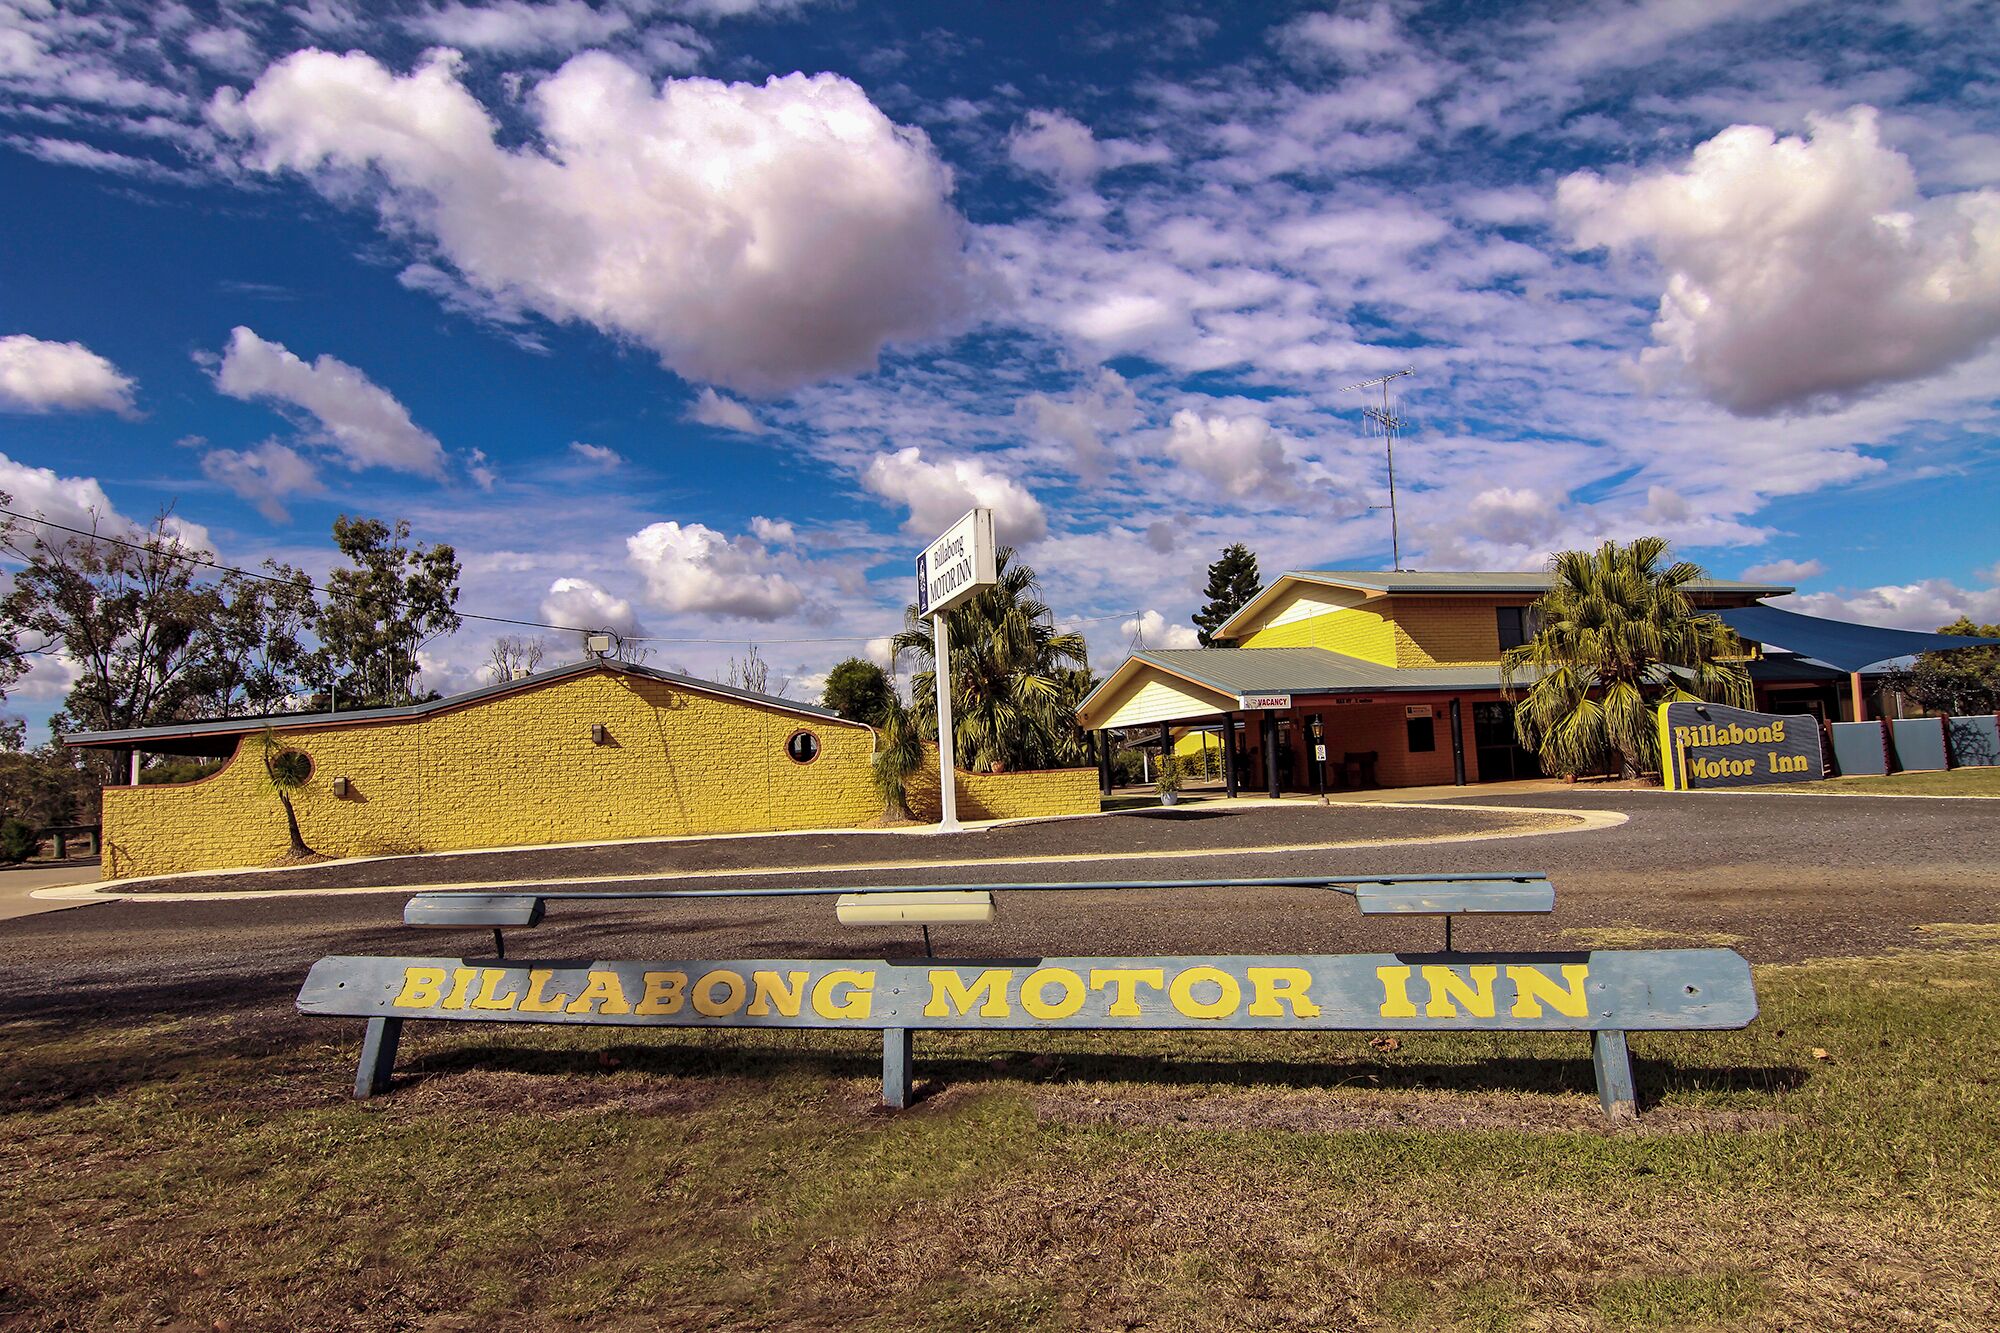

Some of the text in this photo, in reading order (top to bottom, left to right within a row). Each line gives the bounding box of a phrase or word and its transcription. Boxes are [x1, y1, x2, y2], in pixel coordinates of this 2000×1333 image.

[934, 536, 963, 569] Billabong
[930, 555, 971, 603] MOTOR INN
[1258, 698, 1287, 706] VACANCY
[1674, 720, 1785, 749] Billabong
[1687, 751, 1809, 780] Motor Inn
[392, 963, 1590, 1020] BILLABONG MOTOR INN
